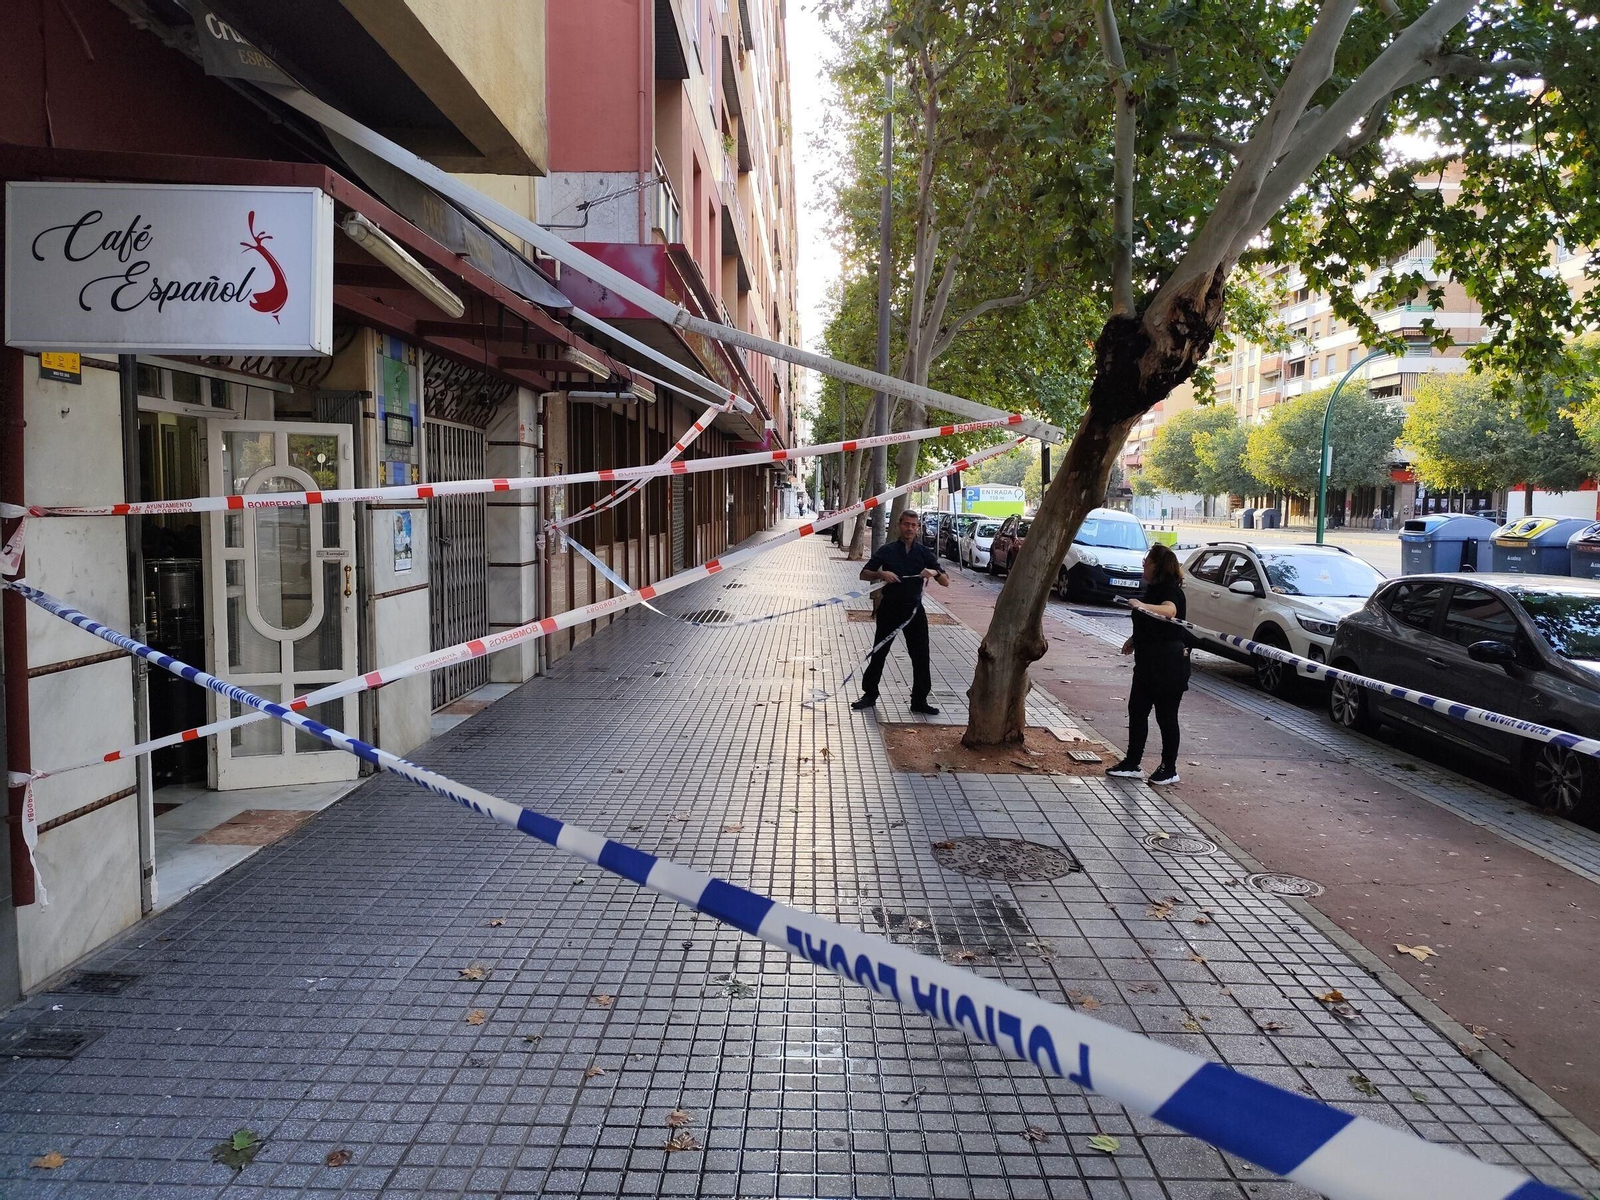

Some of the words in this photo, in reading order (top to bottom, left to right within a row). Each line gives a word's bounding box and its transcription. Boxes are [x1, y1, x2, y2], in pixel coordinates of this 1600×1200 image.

[32, 210, 153, 263] Café
[79, 261, 256, 313] Español
[957, 420, 1005, 433] BOMBEROS
[146, 501, 193, 510] AYUNTAMIENTO
